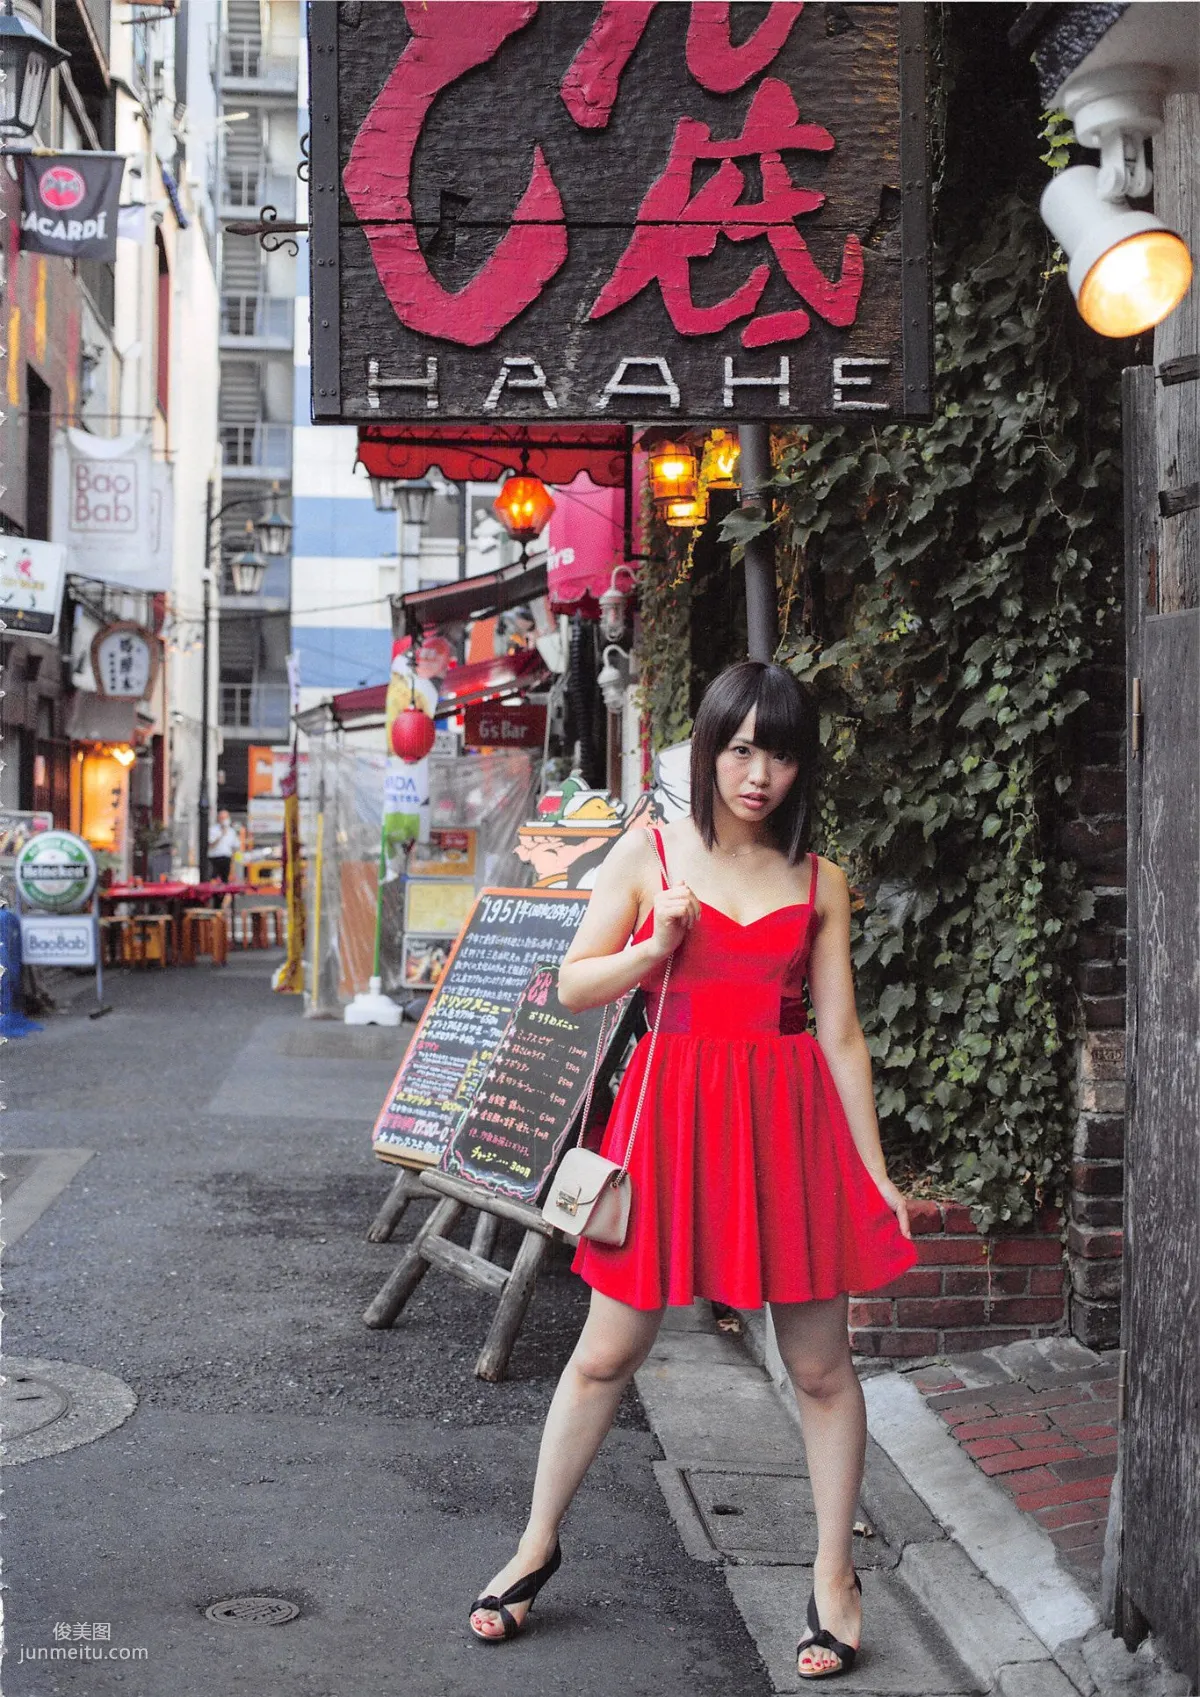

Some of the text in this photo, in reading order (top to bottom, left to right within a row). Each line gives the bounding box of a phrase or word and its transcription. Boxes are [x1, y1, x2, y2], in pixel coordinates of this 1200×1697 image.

[76, 464, 131, 493] Bao
[75, 492, 132, 522] Bab
[528, 1011, 580, 1031] おすすめメニュー
[509, 1160, 532, 1178] 300円
